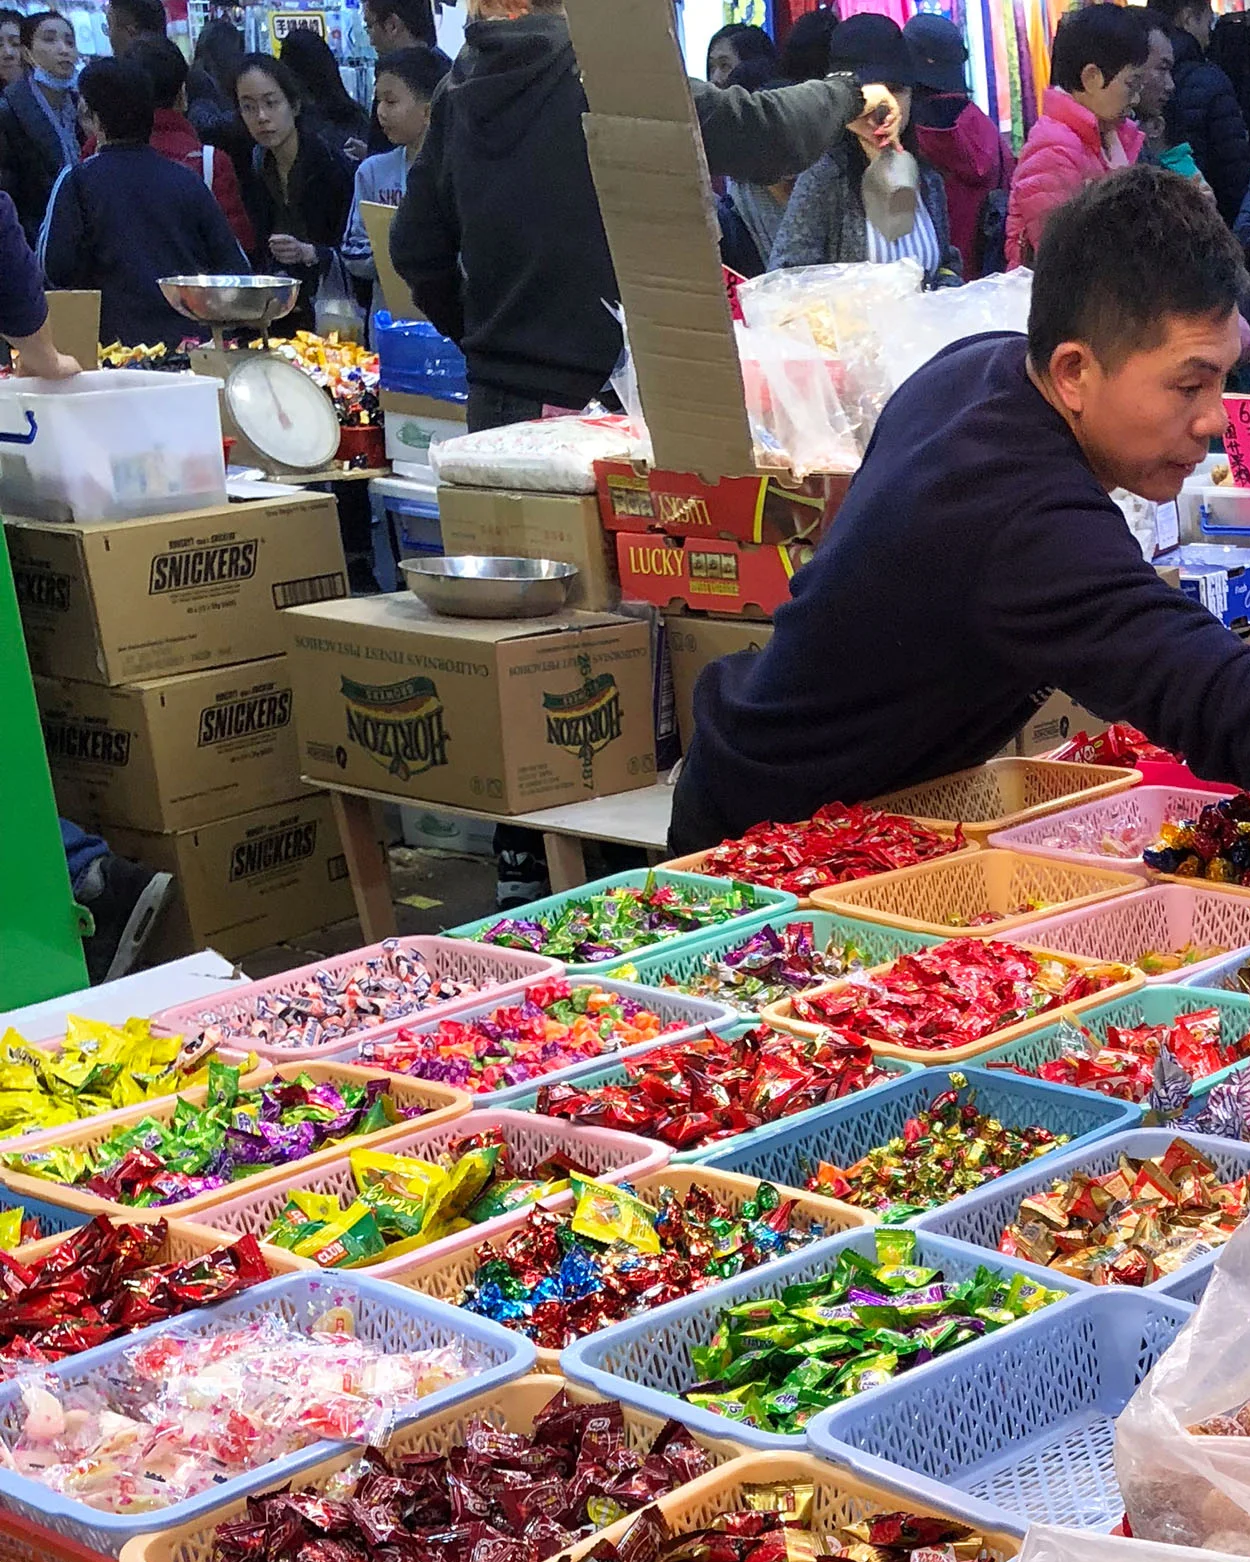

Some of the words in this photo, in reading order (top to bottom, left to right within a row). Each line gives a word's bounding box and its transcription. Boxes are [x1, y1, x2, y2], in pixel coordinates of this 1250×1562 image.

[657, 494, 713, 526] LUCKY
[154, 545, 254, 591] SNICKERS
[629, 546, 685, 576] LUCKY
[203, 693, 289, 742] SNICKERS
[346, 705, 450, 766] HORIZON
[546, 692, 623, 746] HORIZON
[234, 824, 314, 877] SNICKERS
[317, 1241, 345, 1264] CLUB
